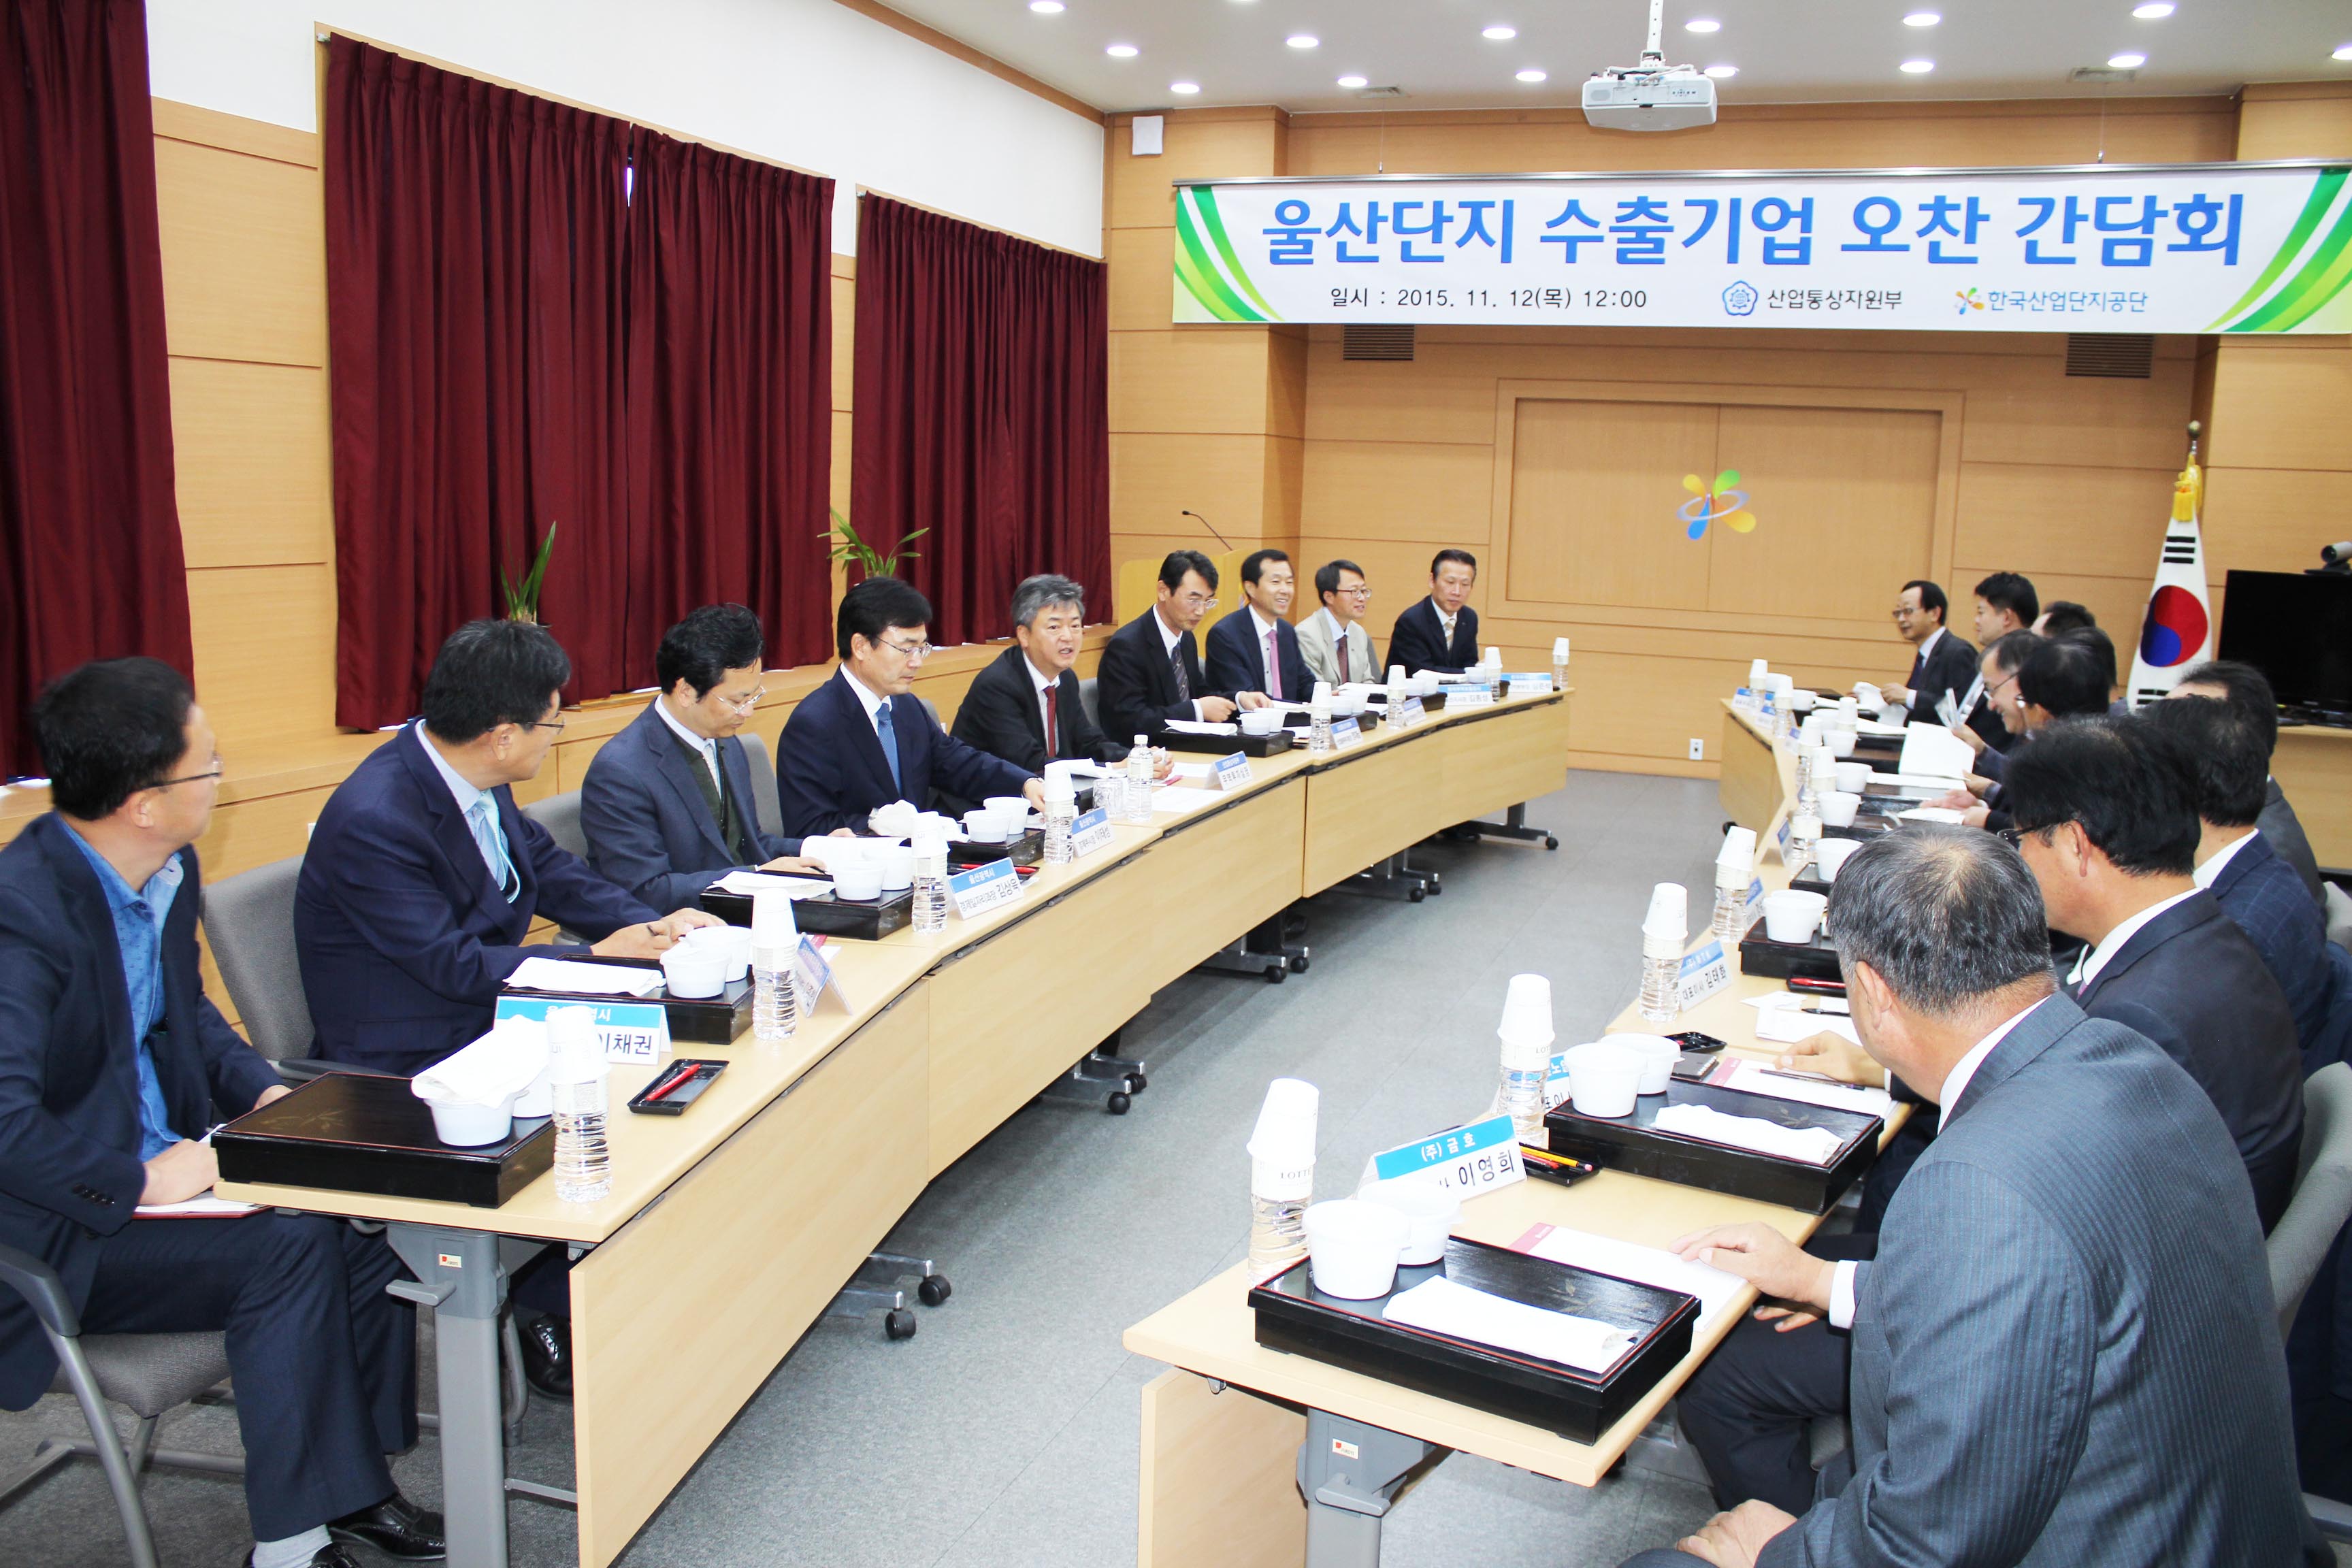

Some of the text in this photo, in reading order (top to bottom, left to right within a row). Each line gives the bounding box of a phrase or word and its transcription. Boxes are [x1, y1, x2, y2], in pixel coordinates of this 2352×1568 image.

[1262, 193, 2244, 267] 울산단지 수출기업 오찬 간담회
[1330, 287, 1368, 308] 일시
[1397, 289, 1455, 308] 2015.
[1467, 289, 1497, 308] 11.
[1510, 287, 1571, 309] 12(목)
[1584, 290, 1647, 308] 12:00
[1767, 289, 1903, 310] 산업통상자원부
[1987, 290, 2149, 314] 한국산업단지공단
[1458, 1149, 1515, 1187] 이영희
